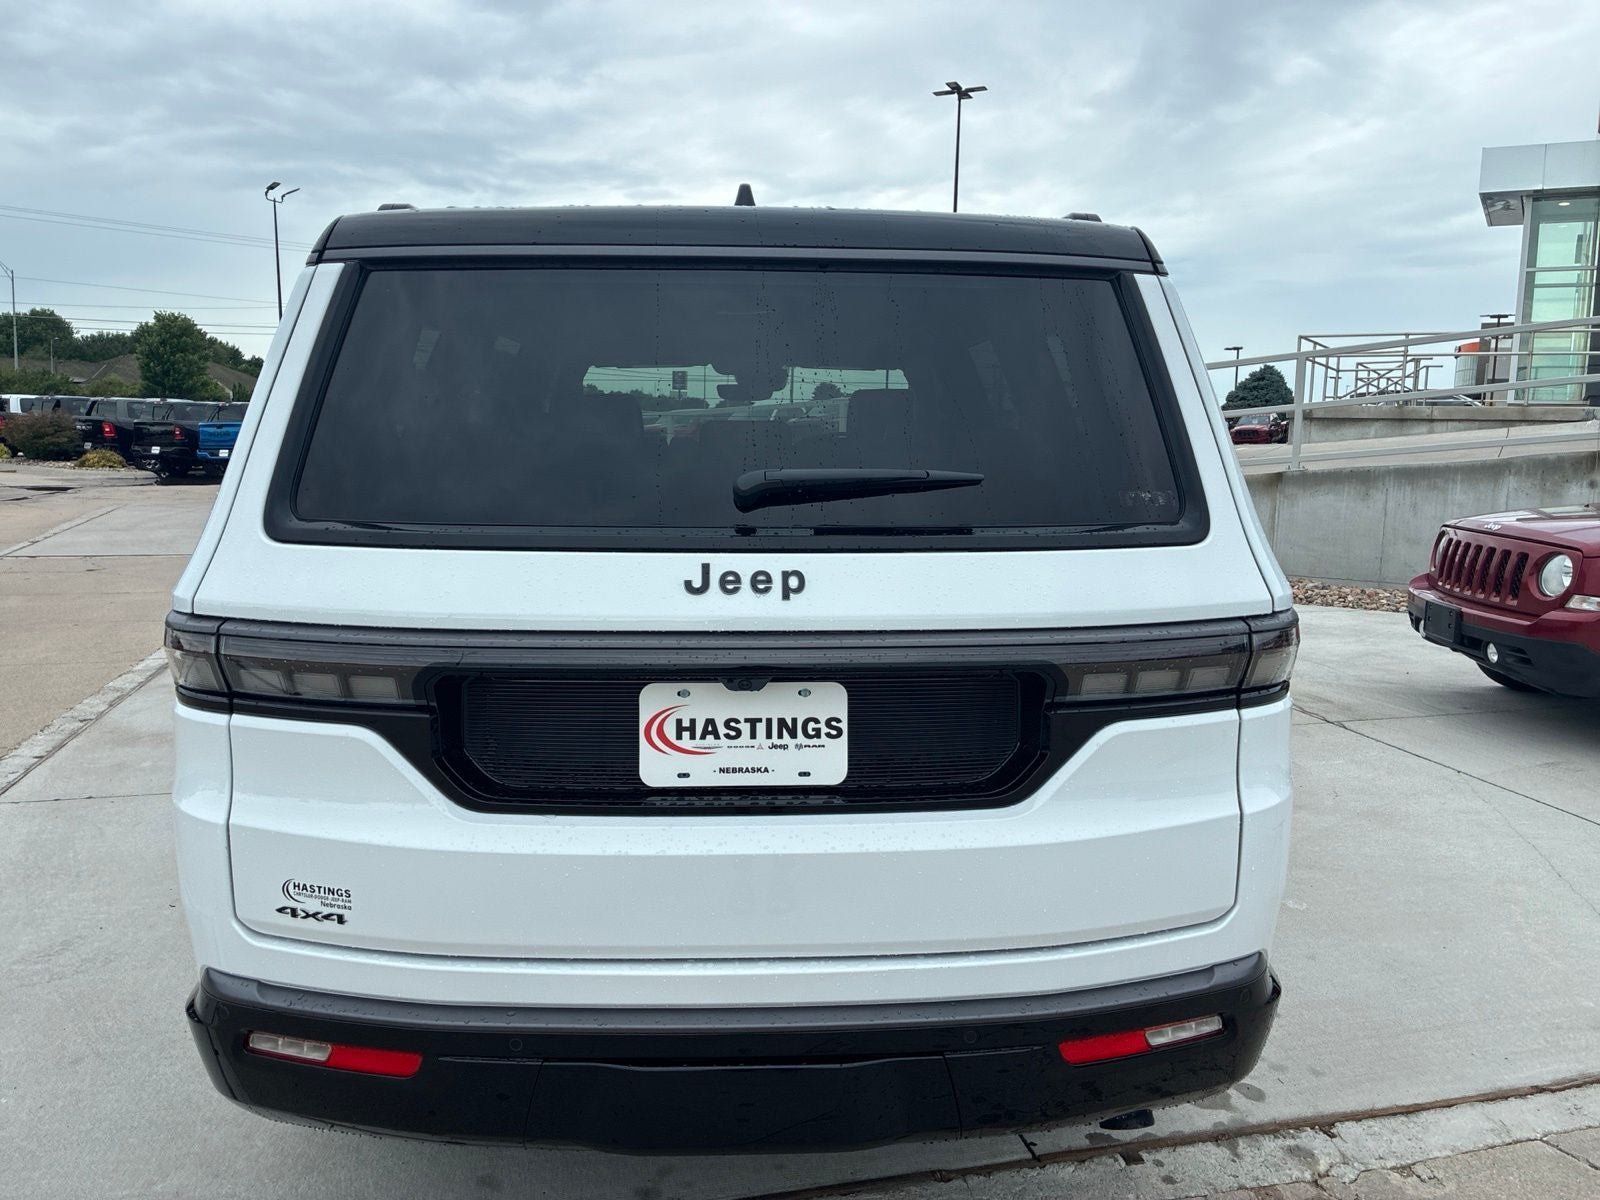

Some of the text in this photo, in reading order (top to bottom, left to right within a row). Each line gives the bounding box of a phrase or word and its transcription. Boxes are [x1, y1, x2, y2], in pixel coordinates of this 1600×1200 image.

[683, 562, 806, 601] Jeep
[675, 716, 844, 741] HASTINGS
[767, 741, 789, 751] Jeep
[718, 766, 770, 774] NEBRASKA
[293, 882, 352, 898] HASTINGS
[320, 900, 352, 911] Nebraska
